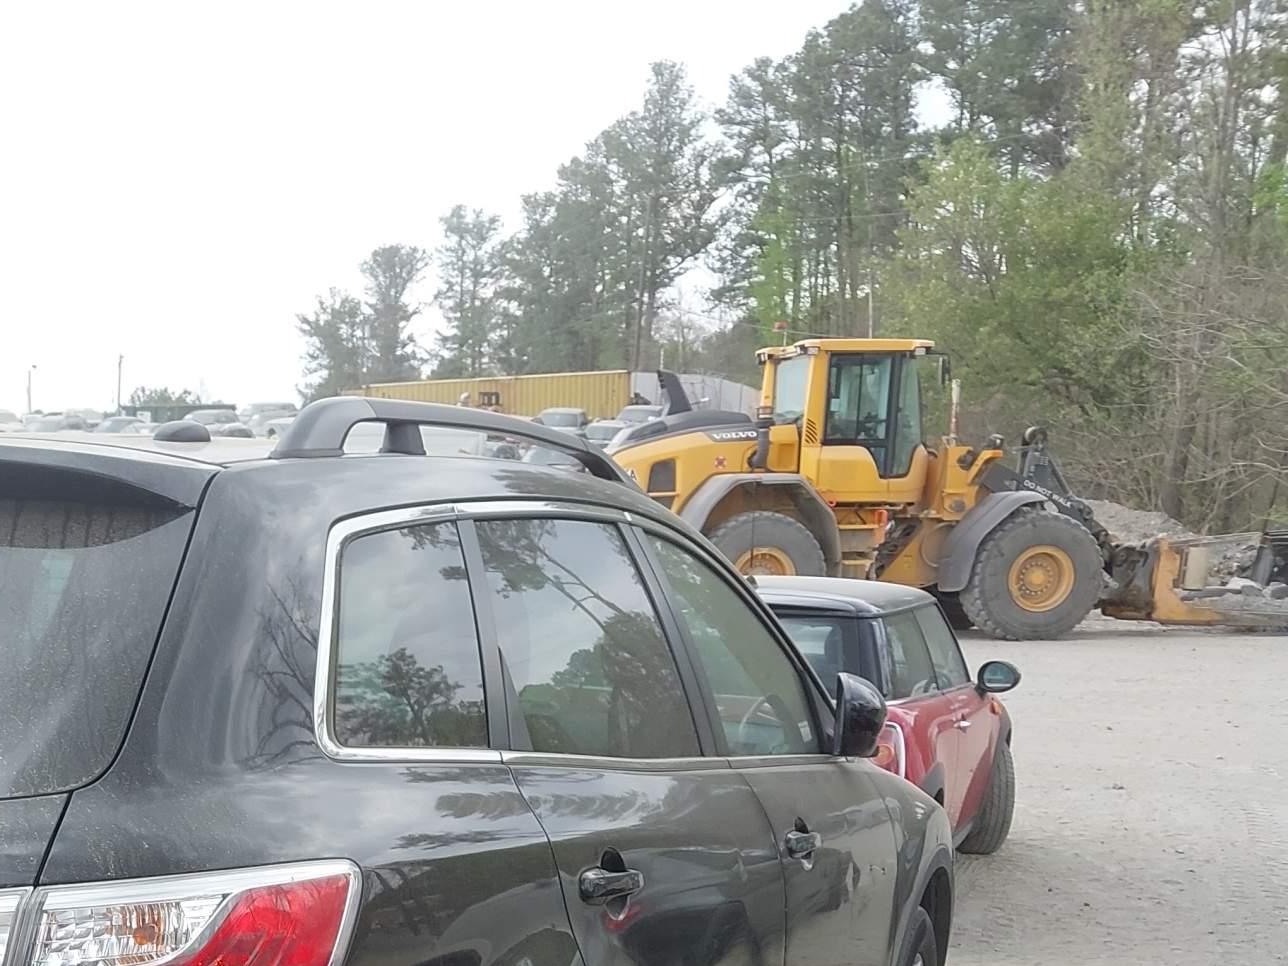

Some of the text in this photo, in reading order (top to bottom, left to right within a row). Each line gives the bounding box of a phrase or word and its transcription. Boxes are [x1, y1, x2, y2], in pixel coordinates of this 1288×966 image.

[712, 431, 758, 439] VOLVO
[1023, 480, 1036, 489] DO
[1036, 485, 1052, 497] NOT
